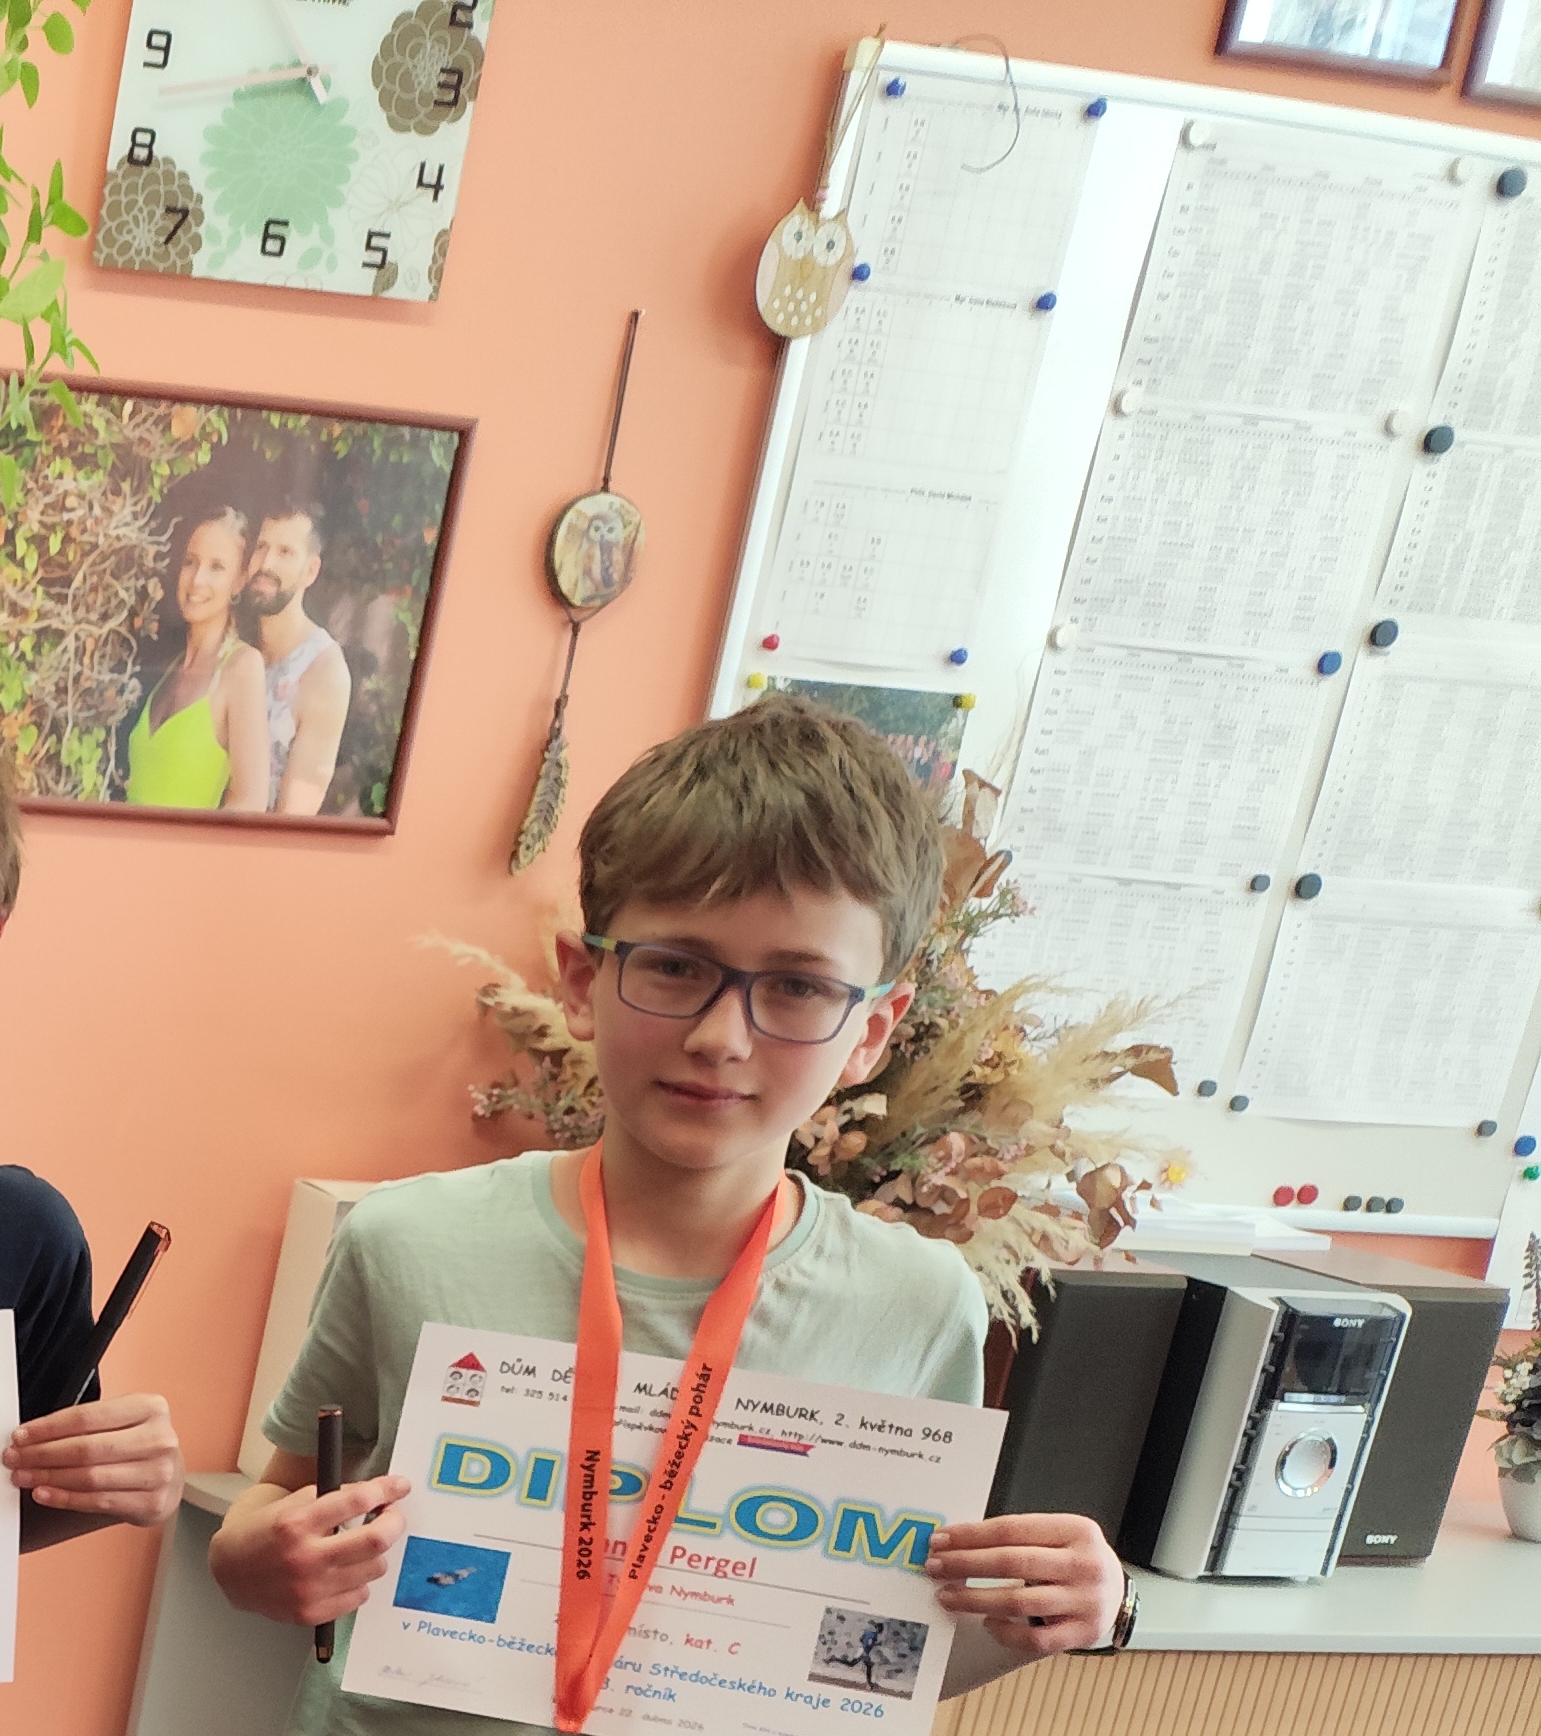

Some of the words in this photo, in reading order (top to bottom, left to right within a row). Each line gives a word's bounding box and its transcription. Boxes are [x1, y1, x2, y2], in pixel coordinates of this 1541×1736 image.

[143, 28, 172, 70] 9
[433, 67, 463, 108] 3
[128, 127, 156, 166] 8
[417, 161, 444, 202] 4
[164, 206, 189, 245] 7
[261, 218, 289, 257] 6
[362, 230, 391, 268] 5
[1333, 1317, 1366, 1328] SONY
[500, 1357, 537, 1378] DŮM
[734, 1397, 825, 1426] NYMBURK,
[858, 1415, 914, 1438] května
[922, 1426, 954, 1445] 968
[579, 1450, 601, 1532] Nymburk
[628, 1503, 664, 1580] Plavecko
[659, 1419, 699, 1492] běžecký
[688, 1363, 713, 1418] pohár
[576, 1536, 594, 1580] 2026
[1365, 1534, 1398, 1545] SONY
[669, 1544, 758, 1579] Pergel
[670, 1584, 735, 1607] Nymburk
[727, 1641, 742, 1656] C
[402, 1620, 411, 1631] v
[649, 1662, 777, 1698] Středočeského
[784, 1686, 832, 1710] kraje
[839, 1697, 886, 1719] 2026
[625, 1681, 678, 1703] ročník
